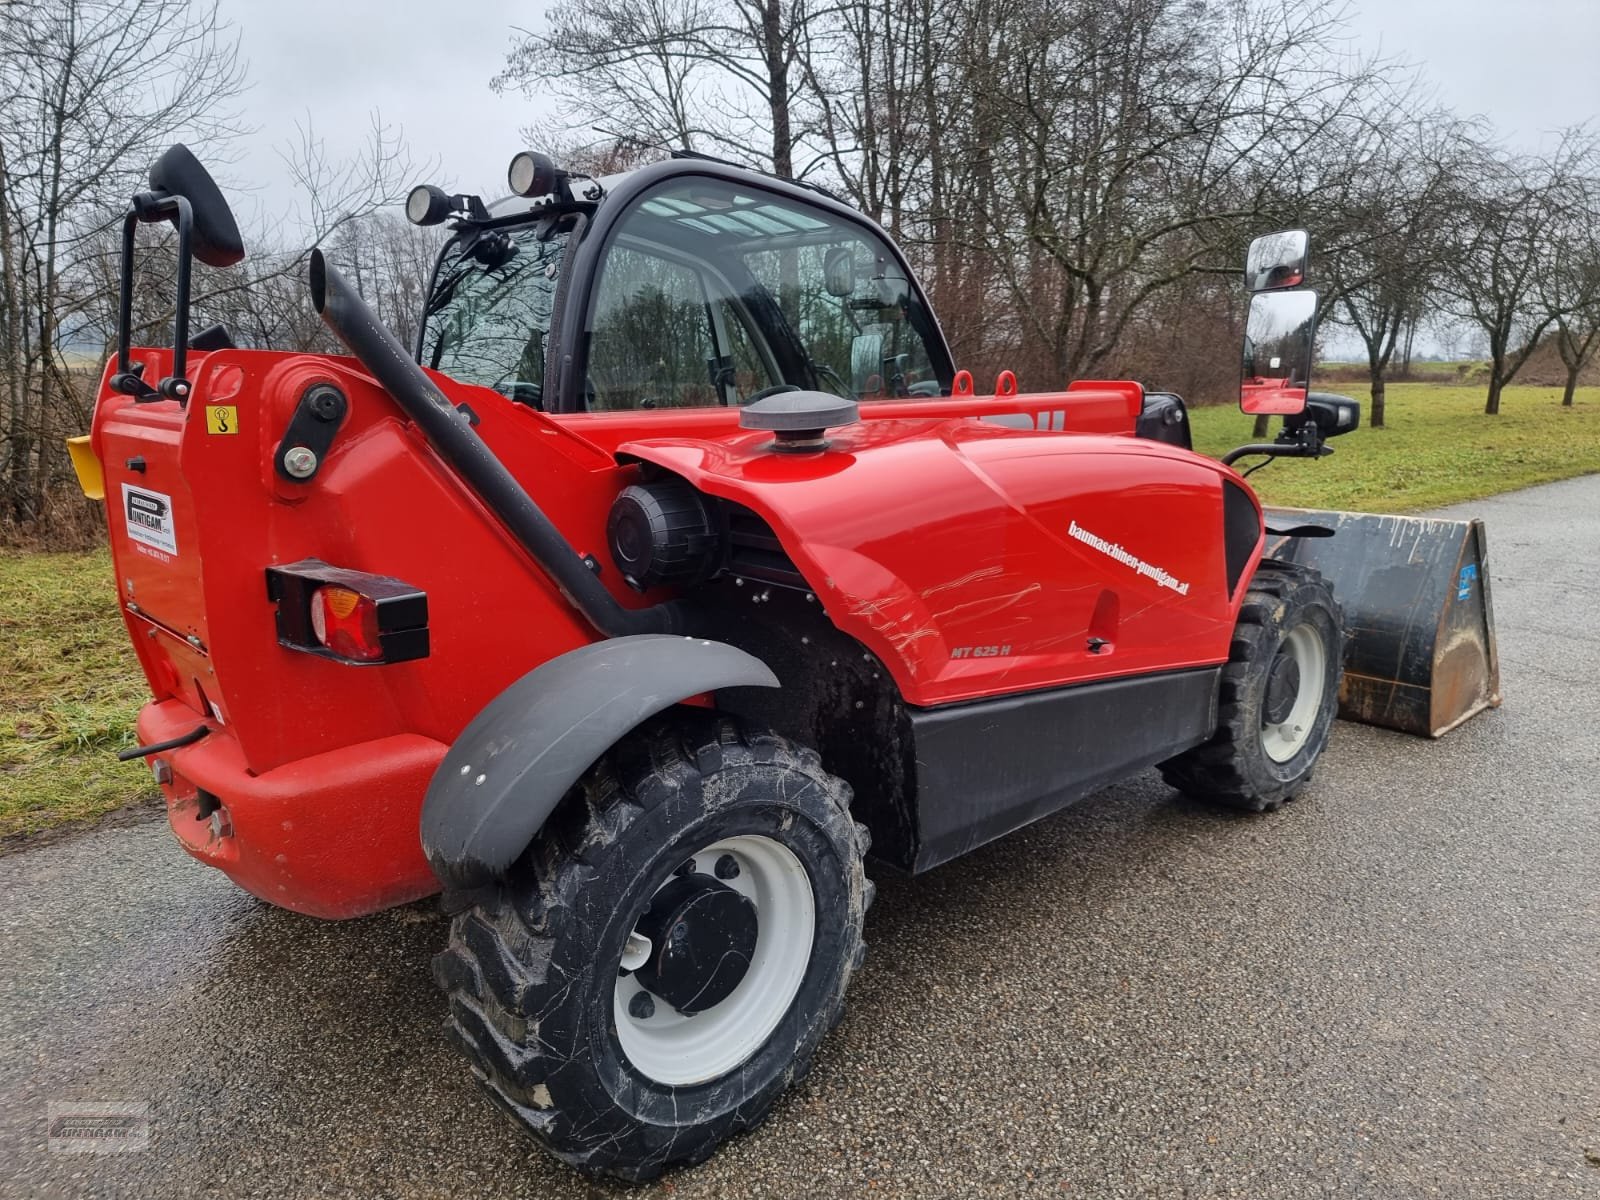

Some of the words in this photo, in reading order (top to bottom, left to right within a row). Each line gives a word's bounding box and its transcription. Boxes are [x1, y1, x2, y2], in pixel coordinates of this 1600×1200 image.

[1068, 520, 1189, 596] baumaschinen-puntigam.at
[951, 647, 971, 658] MT
[974, 646, 998, 657] 625
[1001, 645, 1012, 656] H
